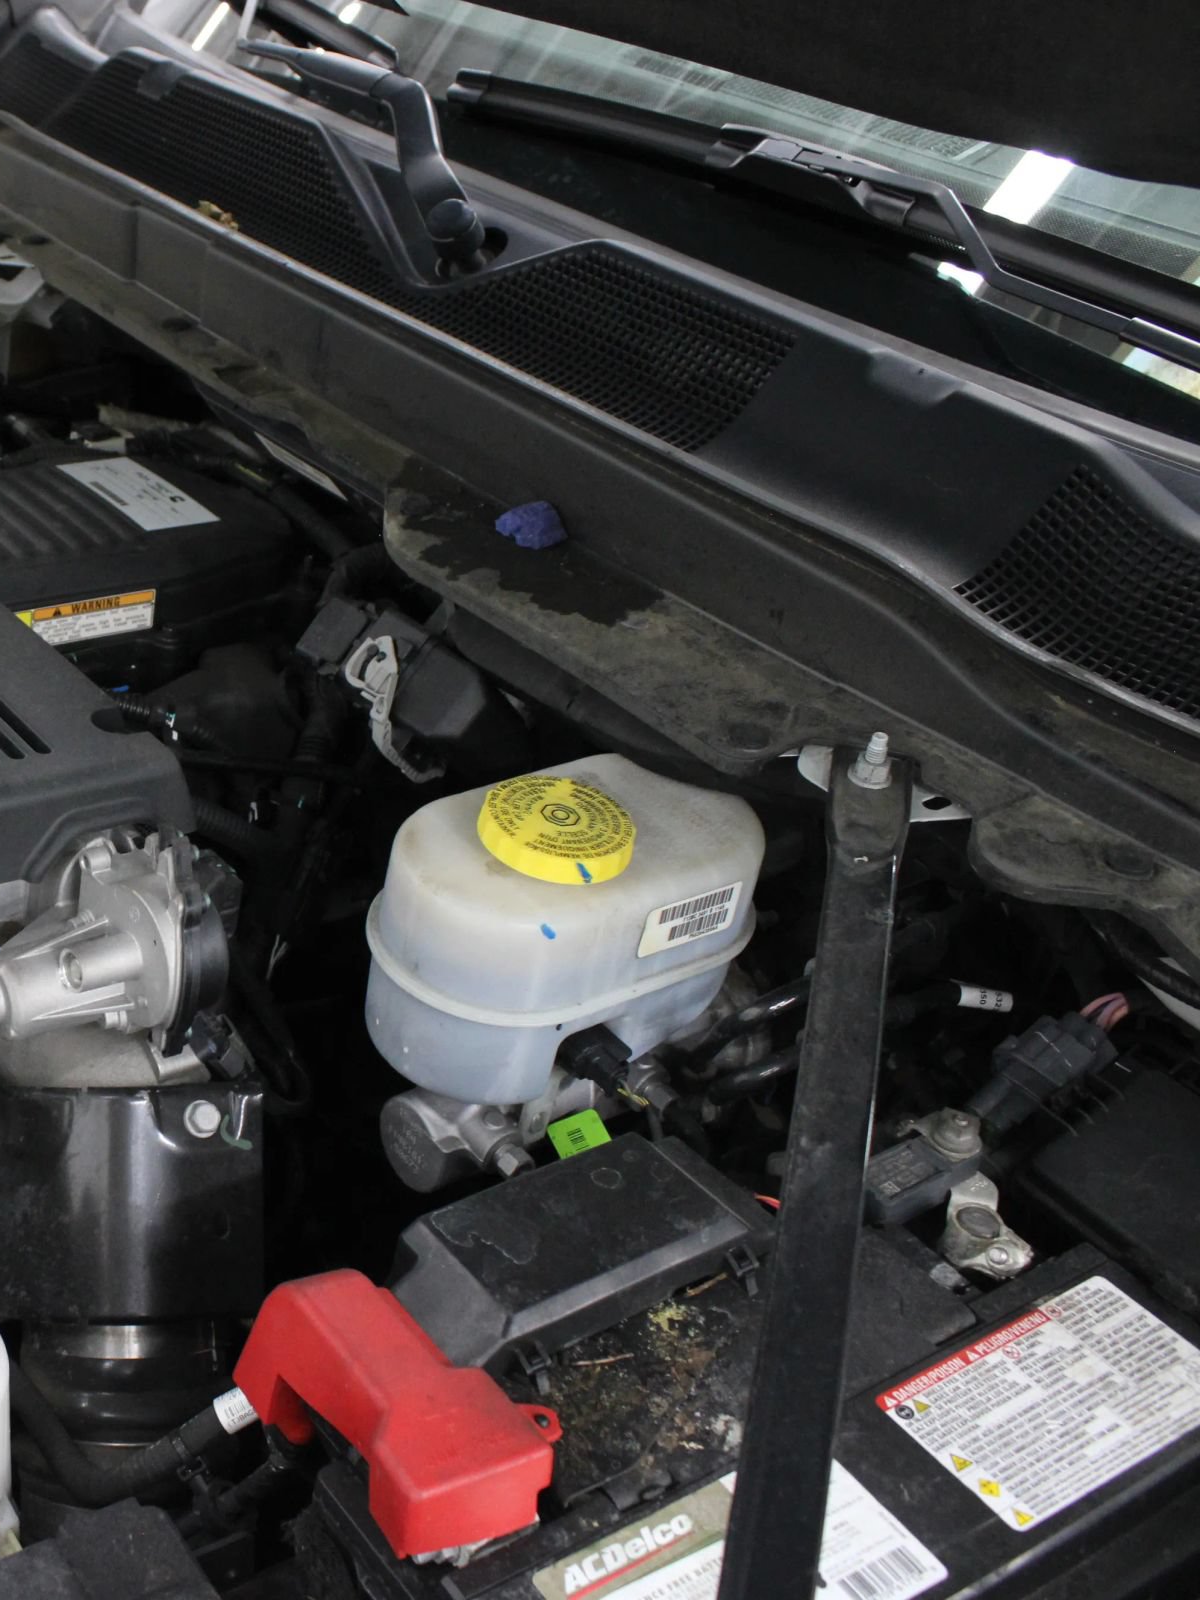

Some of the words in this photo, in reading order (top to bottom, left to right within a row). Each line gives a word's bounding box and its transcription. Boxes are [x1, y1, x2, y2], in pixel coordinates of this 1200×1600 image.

[71, 596, 120, 614] WARNING
[891, 1356, 967, 1402] DANGER/POISON
[973, 1311, 1047, 1355] PELIGRO/VENENO
[564, 1513, 693, 1595] ACDelco
